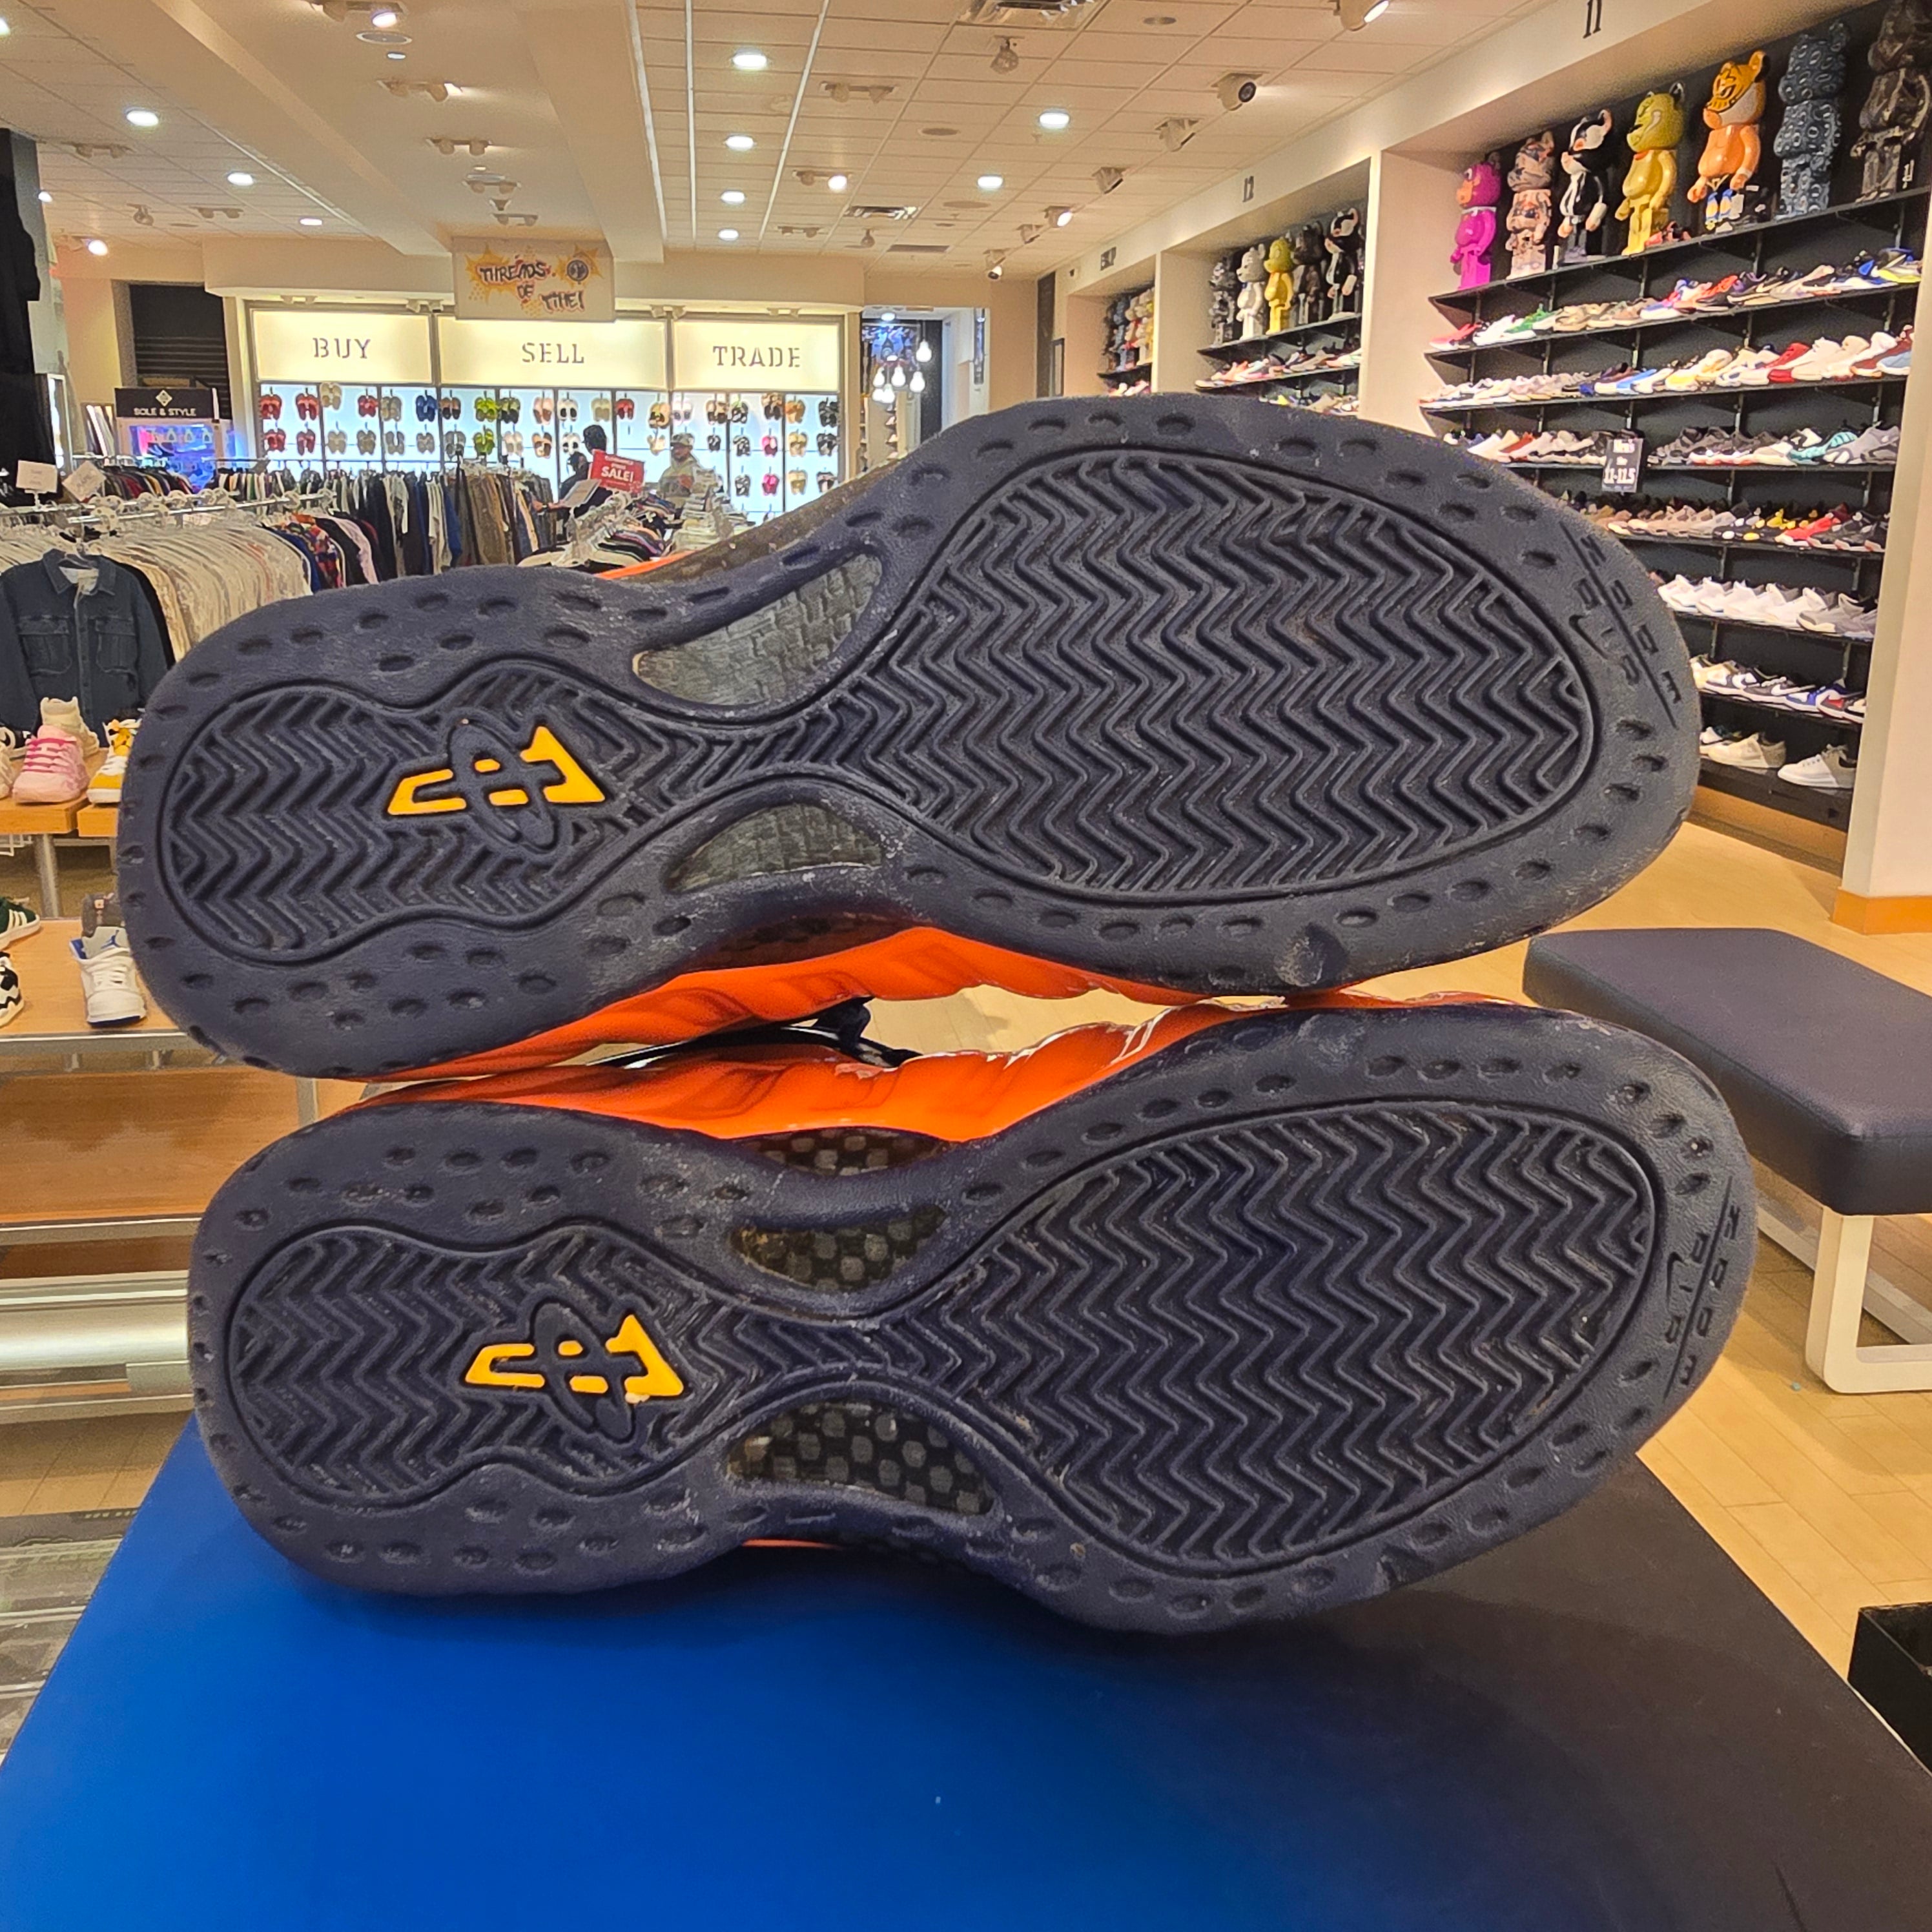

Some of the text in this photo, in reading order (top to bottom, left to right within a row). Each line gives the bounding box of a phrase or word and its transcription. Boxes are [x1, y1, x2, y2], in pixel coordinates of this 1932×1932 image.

[313, 337, 371, 359] BUY
[522, 342, 585, 364] SELL
[713, 345, 801, 368] TRADE
[134, 407, 157, 416] SOLE
[168, 408, 196, 416] STYLE
